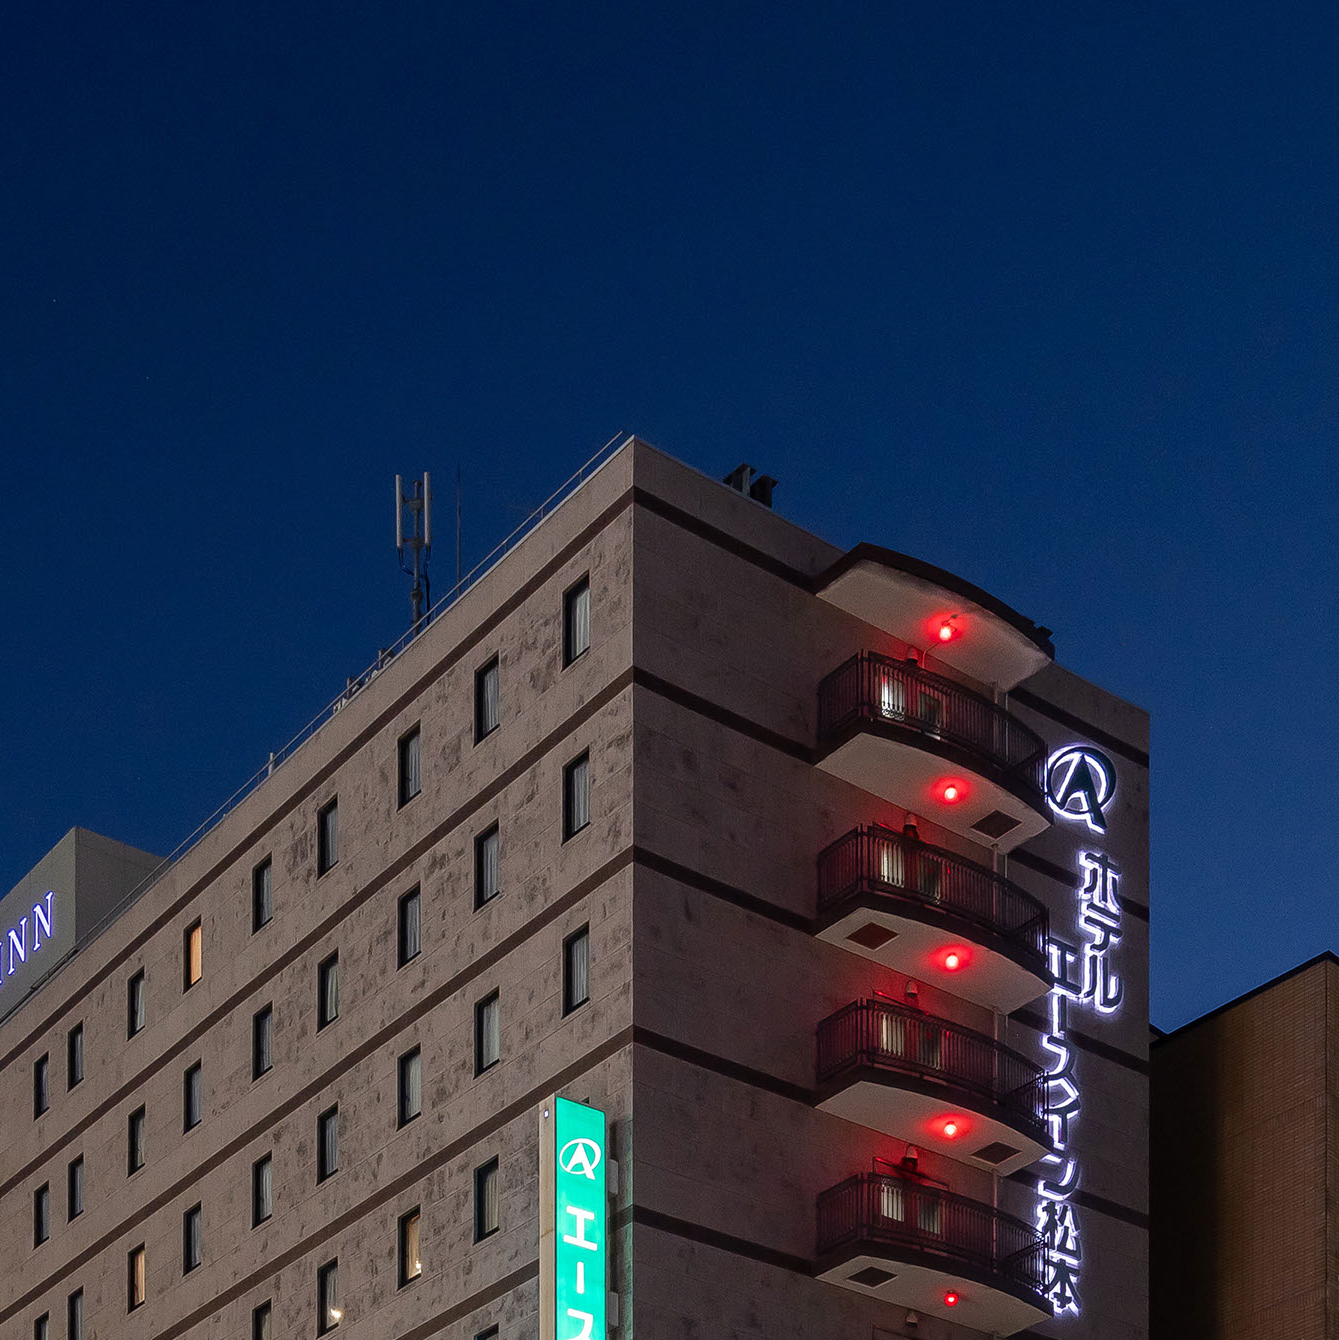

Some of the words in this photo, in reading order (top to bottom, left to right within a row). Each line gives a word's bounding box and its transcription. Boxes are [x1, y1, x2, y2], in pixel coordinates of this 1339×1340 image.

[1080, 851, 1125, 1011] ホテル
[1038, 938, 1082, 1318] エースイン松本
